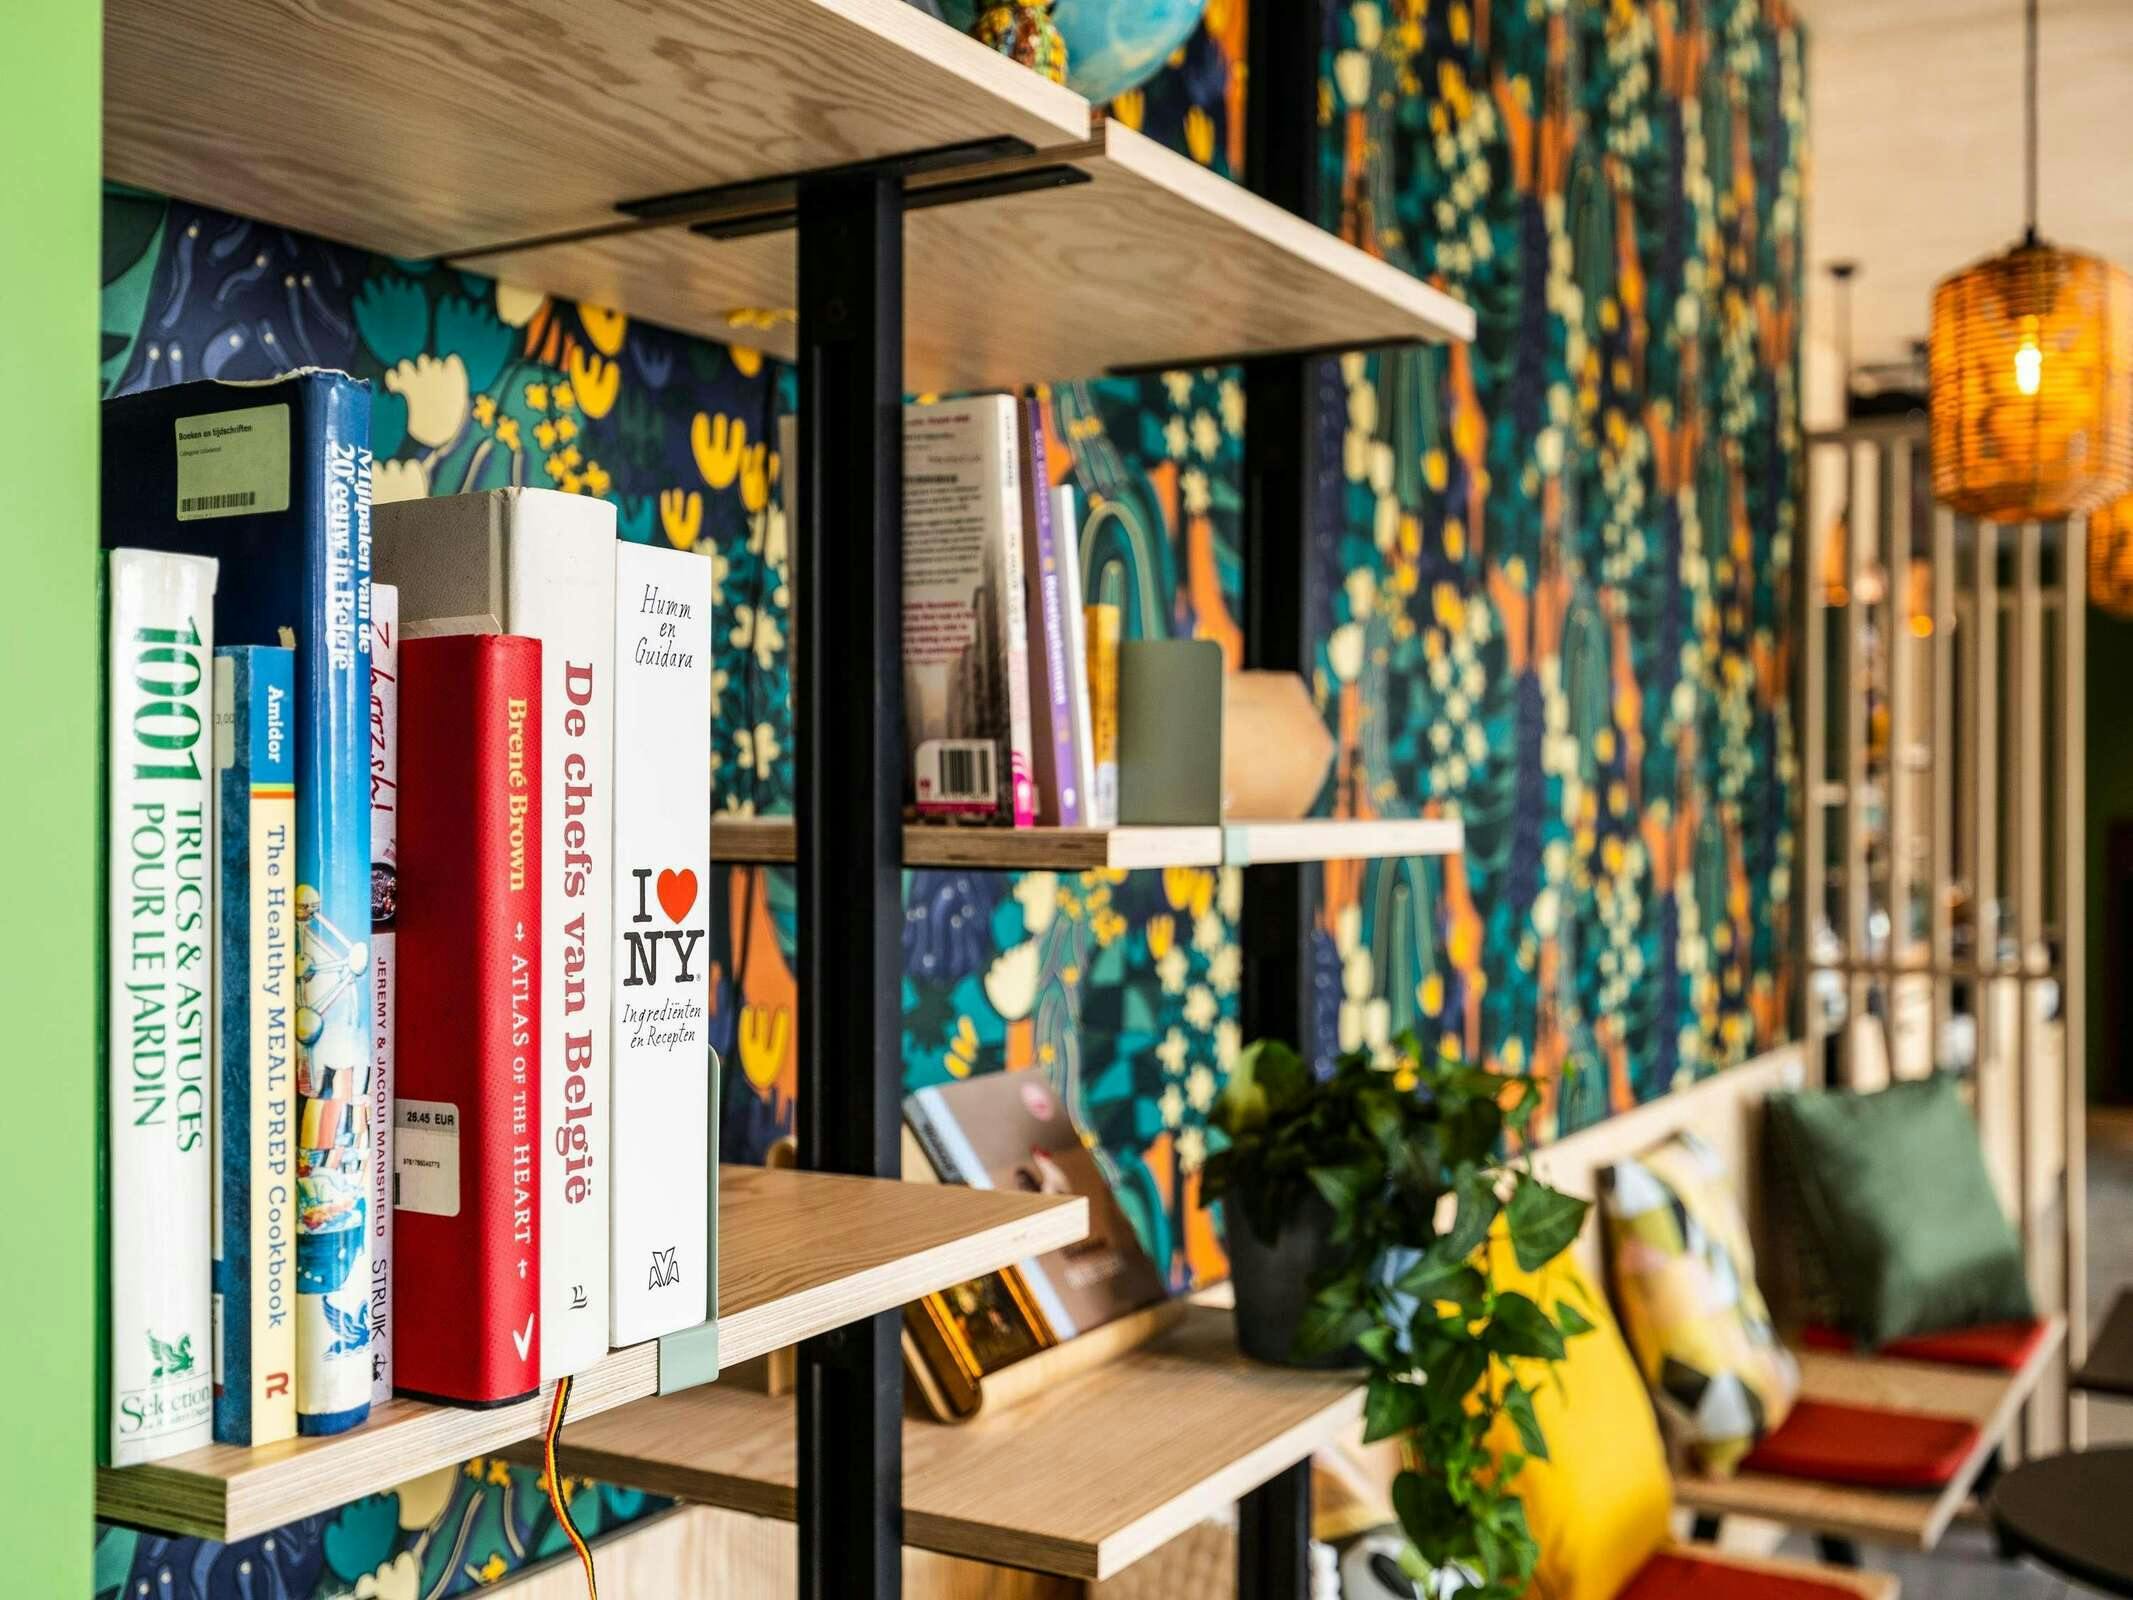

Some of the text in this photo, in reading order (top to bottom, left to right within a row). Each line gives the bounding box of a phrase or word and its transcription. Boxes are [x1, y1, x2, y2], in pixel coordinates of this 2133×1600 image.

[179, 432, 202, 441] Boeken
[212, 424, 252, 438] tijdschriften
[332, 482, 349, 553] eeuw
[354, 446, 373, 654] Mijlpalen van de
[332, 558, 355, 585] in
[640, 584, 692, 619] Humm
[327, 589, 355, 671] België
[635, 637, 693, 669] Guidara
[660, 622, 676, 637] en
[133, 616, 202, 781] 1001
[268, 685, 284, 763] Amidor
[508, 697, 527, 892] Brené Brown
[125, 803, 166, 1127] POUR LE JARDIN
[556, 661, 593, 1204] De chefs van België
[176, 802, 203, 1153] TRUCS & ASTUCES
[622, 998, 702, 1034] Ingrediënten
[263, 824, 286, 1328] The Healthy MEAL PREP Cookbook
[630, 1027, 696, 1053] en Recepten
[375, 957, 386, 1237] JEREMY & JACQUI MANSFIELD
[435, 1113, 455, 1126] EUR
[511, 955, 531, 1244] ATLAS OF THE HEART
[372, 1259, 387, 1339] STRUIK
